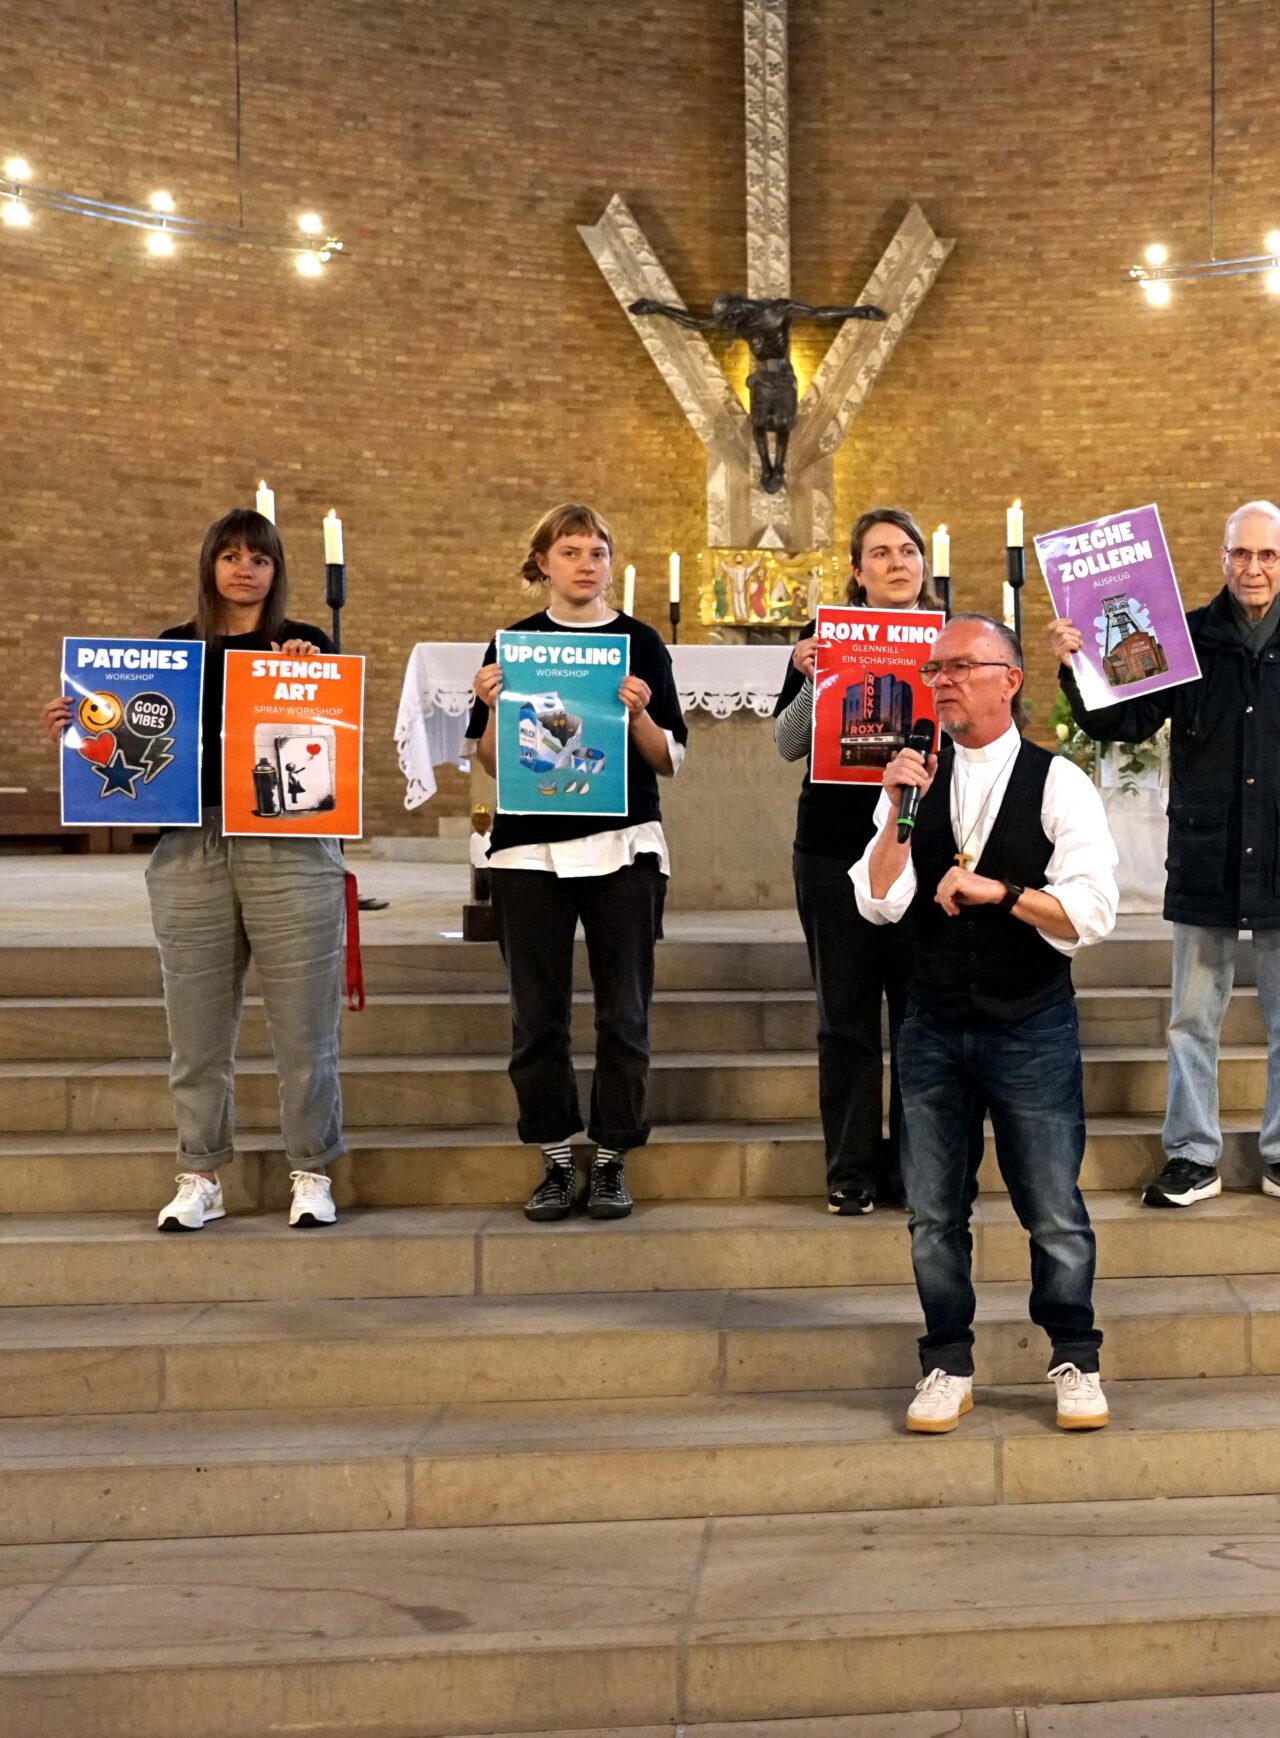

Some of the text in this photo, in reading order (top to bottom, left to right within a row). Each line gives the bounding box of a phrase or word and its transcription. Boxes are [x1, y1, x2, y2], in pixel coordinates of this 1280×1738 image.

[1064, 521, 1135, 557] ZECHE
[1058, 540, 1153, 583] ZOLLERN
[1093, 572, 1131, 589] AUSFLUG
[820, 622, 938, 643] ROXY KINO
[504, 644, 621, 665] UPCYCLING
[852, 644, 900, 654] GLENNKILL
[77, 648, 188, 670] PATCHES
[842, 656, 916, 666] EIN SCHAFSKRIMI
[105, 673, 154, 681] WORKSHOP
[252, 659, 341, 680] STENCIL
[536, 669, 590, 678] WORKSHOP
[274, 683, 318, 701] ART
[867, 674, 875, 720] ROXY
[135, 701, 168, 717] GOOD
[254, 705, 343, 716] SPRAY-WORKSHOP
[131, 712, 165, 729] VIBES
[850, 723, 884, 734] ROXY
